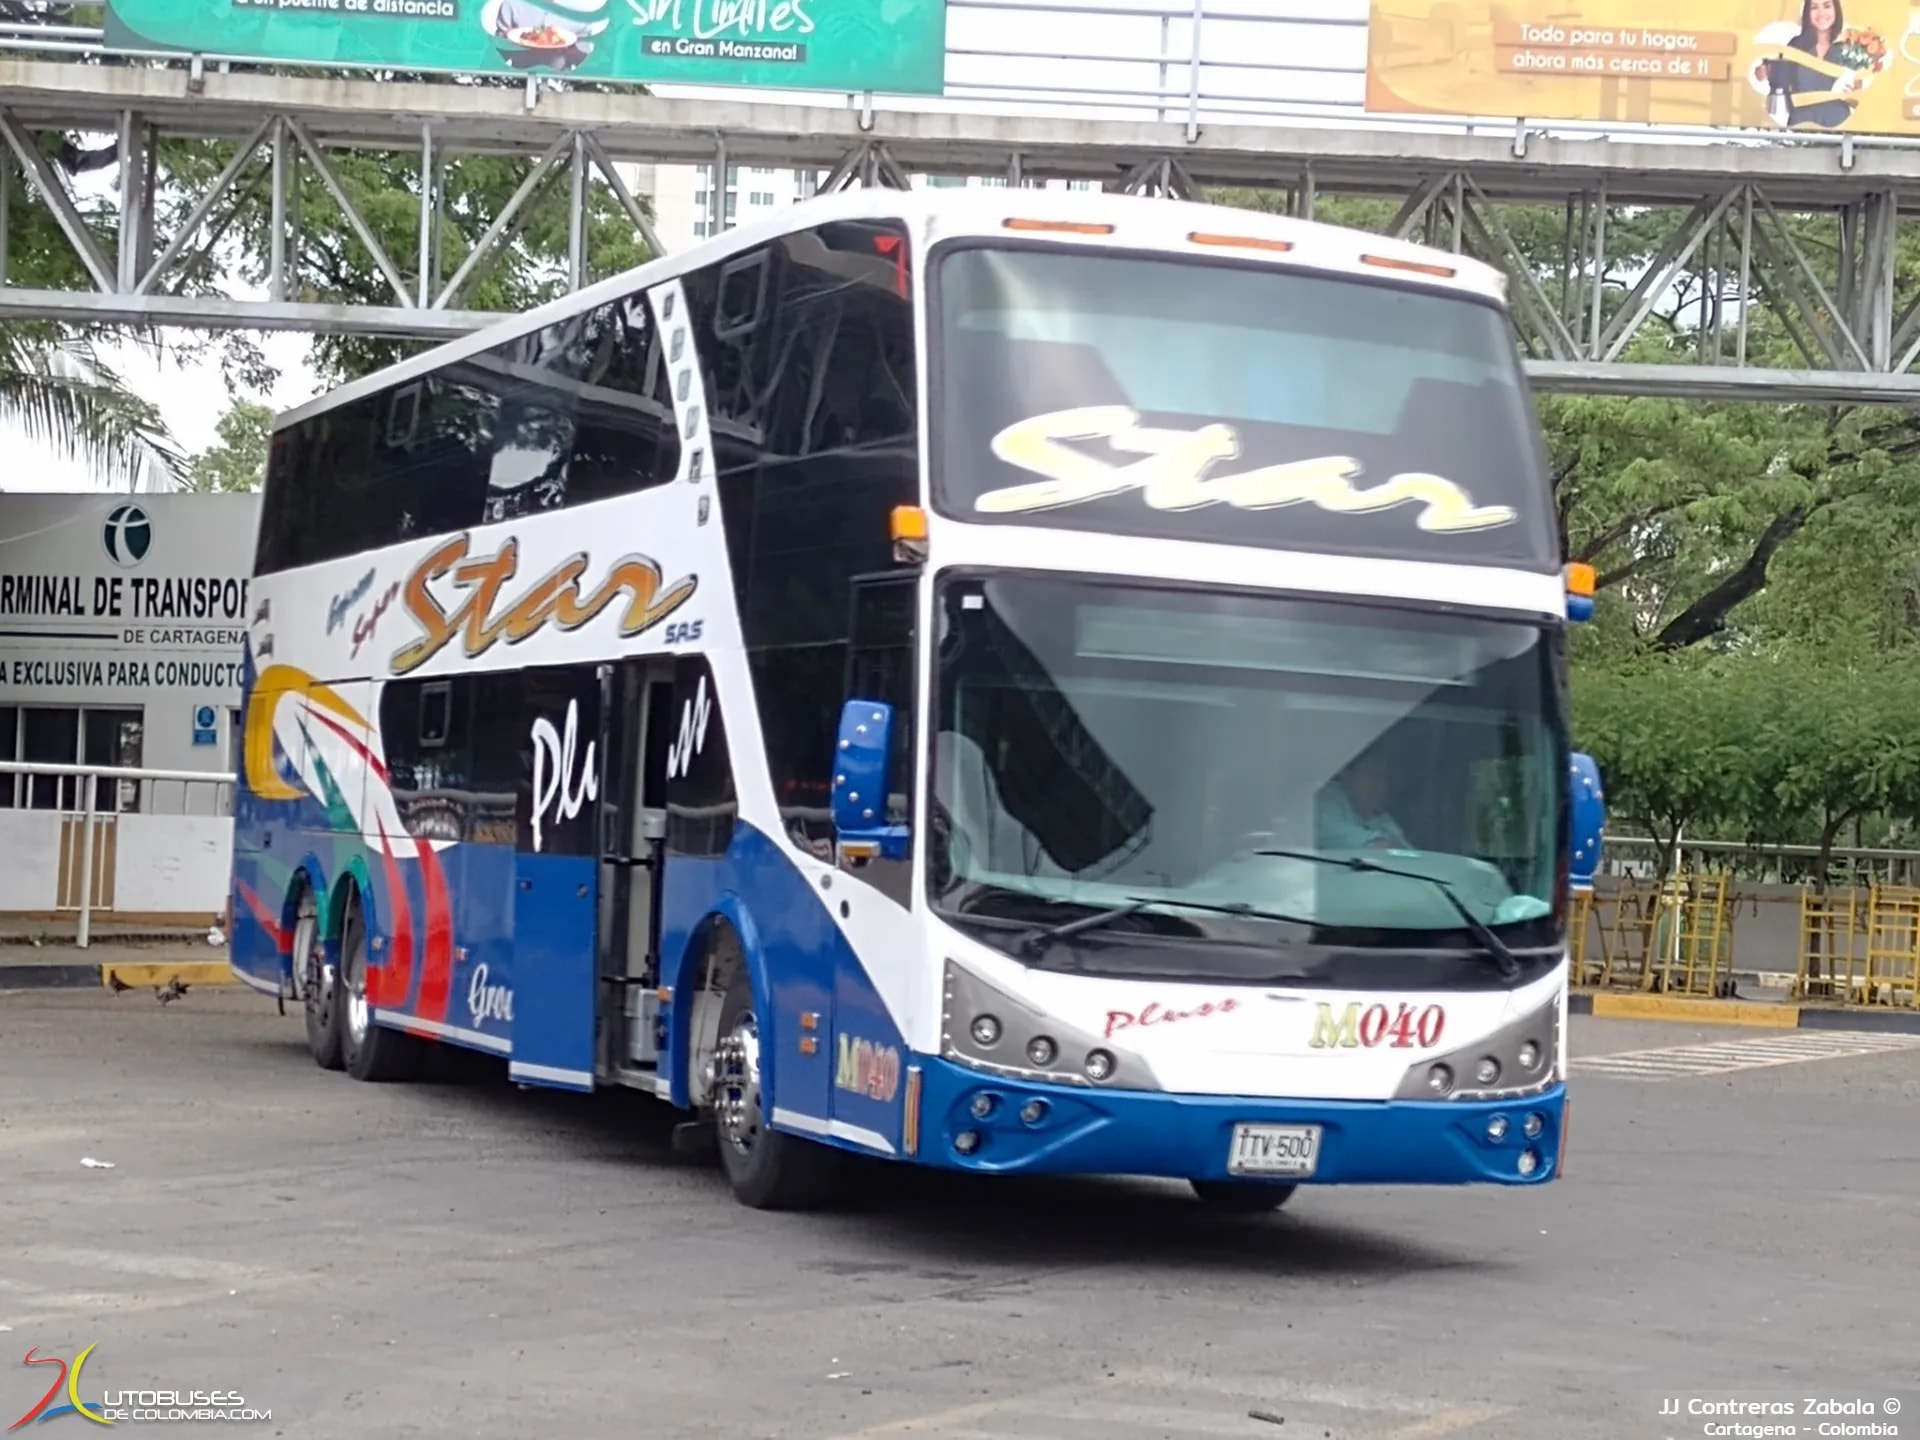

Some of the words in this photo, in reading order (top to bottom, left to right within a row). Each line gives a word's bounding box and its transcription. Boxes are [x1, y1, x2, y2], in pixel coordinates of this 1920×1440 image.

[373, 0, 454, 16] distancia
[651, 41, 671, 54] en
[676, 39, 714, 55] Gran
[1520, 24, 1565, 43] Todo
[1570, 29, 1614, 46] para
[1620, 29, 1637, 45] tu
[1642, 30, 1697, 50] hogar,
[1512, 50, 1565, 68] ahora
[1609, 57, 1662, 73] cerca
[1668, 57, 1691, 74] de
[1697, 58, 1708, 74] ti
[974, 404, 1518, 534] Star
[0, 575, 85, 616] RMINAL
[94, 577, 123, 616] DE
[389, 532, 698, 676] Star
[123, 629, 144, 644] DE
[13, 661, 103, 686] EXCLUSIVA
[107, 661, 150, 687] PARA
[1308, 1001, 1446, 1048] M040
